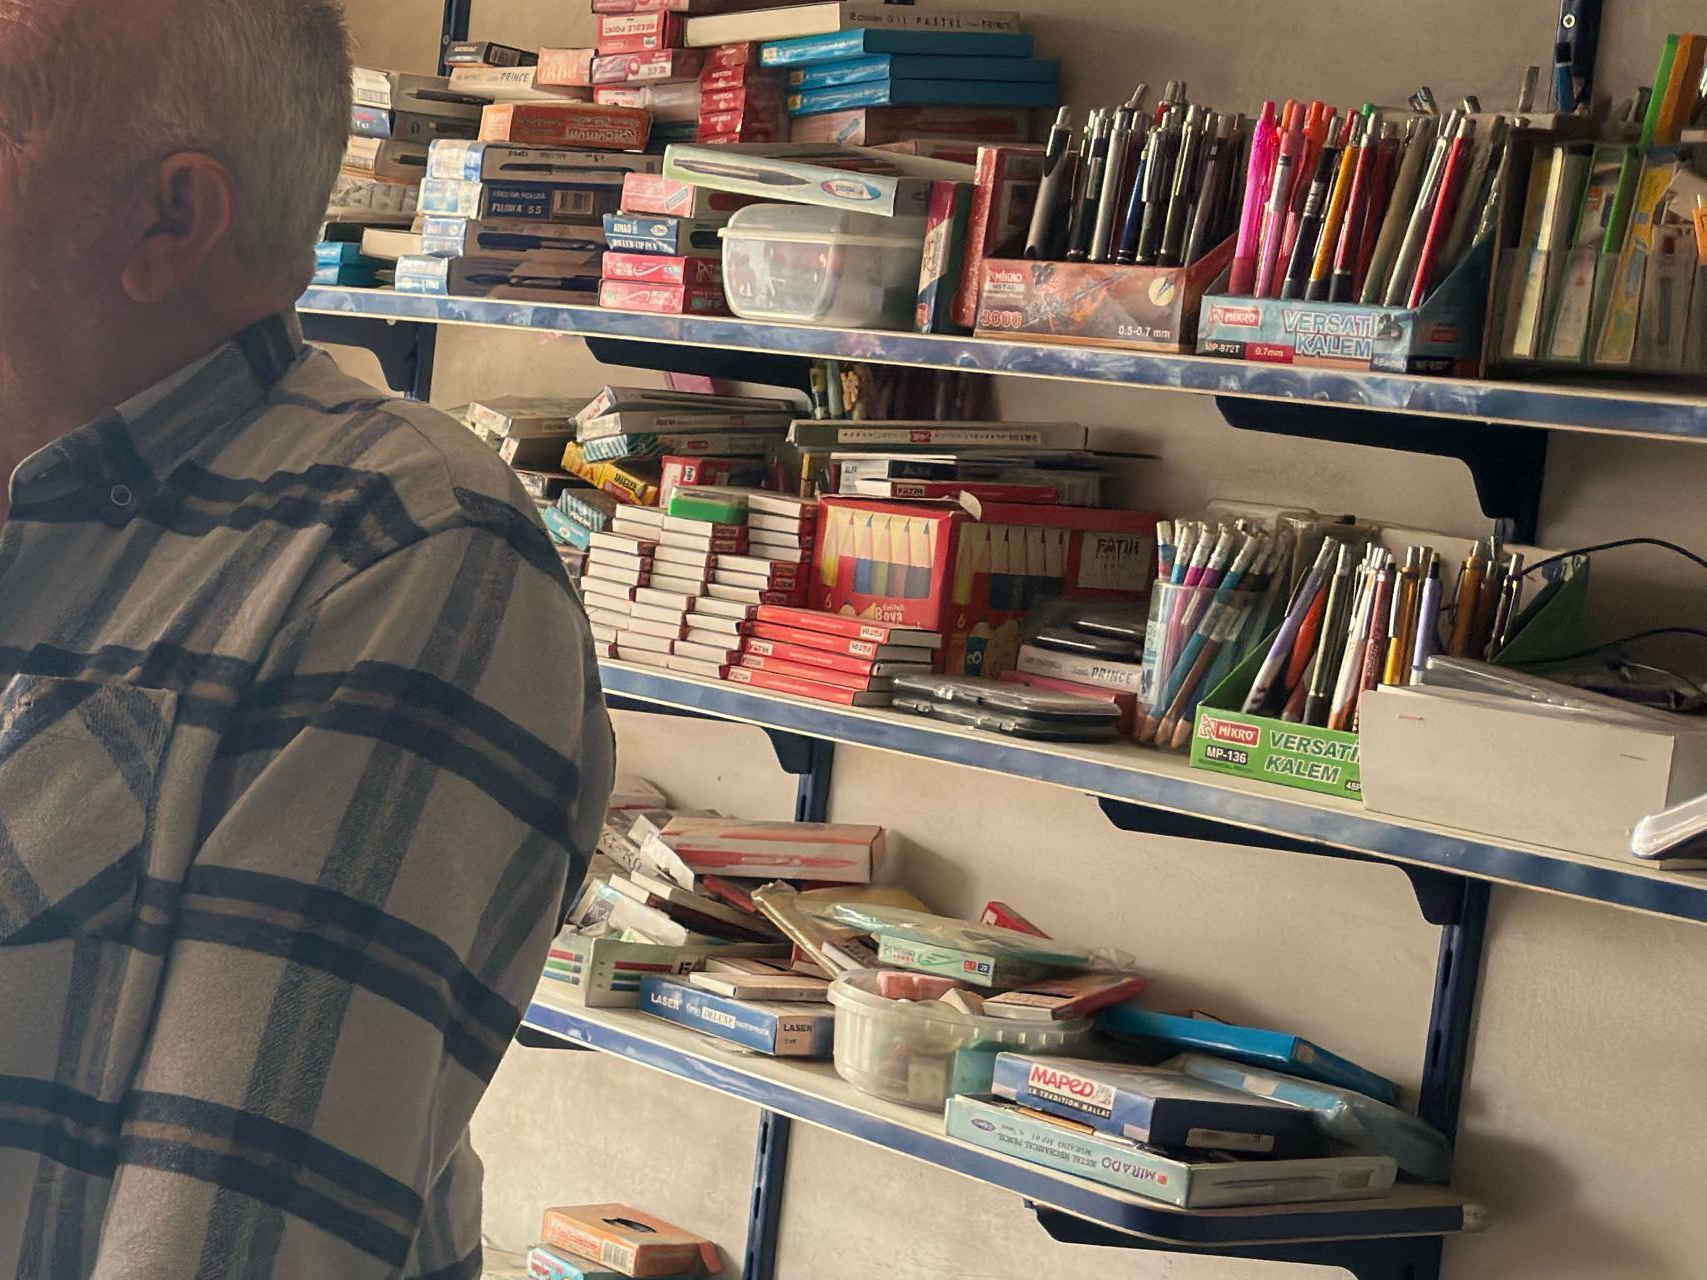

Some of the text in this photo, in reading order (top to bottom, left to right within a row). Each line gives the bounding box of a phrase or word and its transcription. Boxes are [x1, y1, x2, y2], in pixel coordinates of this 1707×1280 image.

[499, 71, 530, 84] PRINCE
[979, 308, 1023, 329] 3000
[1283, 309, 1377, 337] VERSATİ
[1118, 324, 1172, 340] 0.5-0.7 mm
[1254, 346, 1285, 358] 0.7mm
[1295, 332, 1373, 358] KALEM
[1091, 666, 1133, 684] PRINCE
[1218, 723, 1256, 742] MİKRO
[1206, 746, 1248, 764] MP-136
[1269, 729, 1361, 764] VERSATİ
[1264, 755, 1342, 786] KALEM
[650, 993, 680, 1011] LASER
[783, 1023, 813, 1034] LASER
[1100, 1156, 1156, 1181] MIRADO
